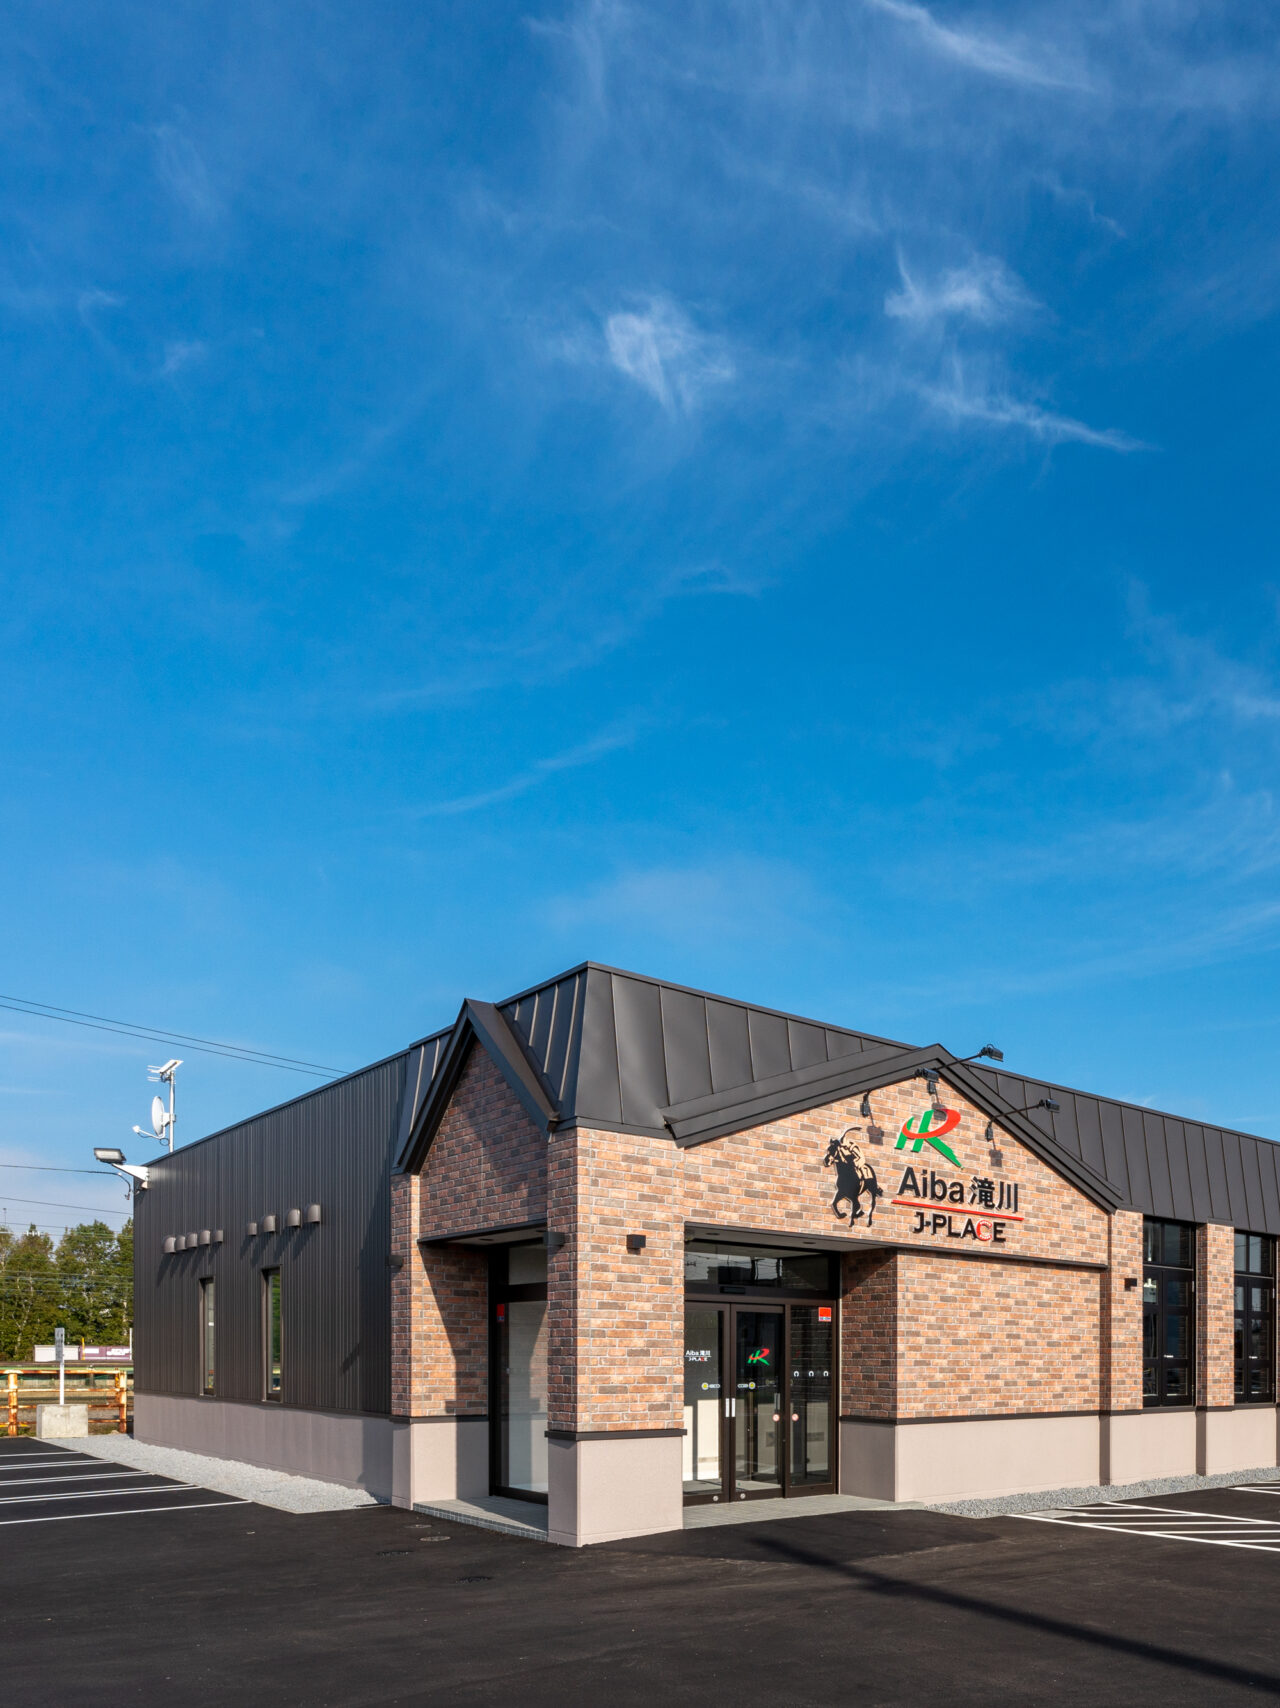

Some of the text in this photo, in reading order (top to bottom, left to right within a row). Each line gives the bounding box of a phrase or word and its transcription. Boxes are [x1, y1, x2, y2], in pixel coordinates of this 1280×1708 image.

[897, 1166, 1019, 1213] Aiba 滝川
[912, 1211, 1007, 1243] J-PLACE
